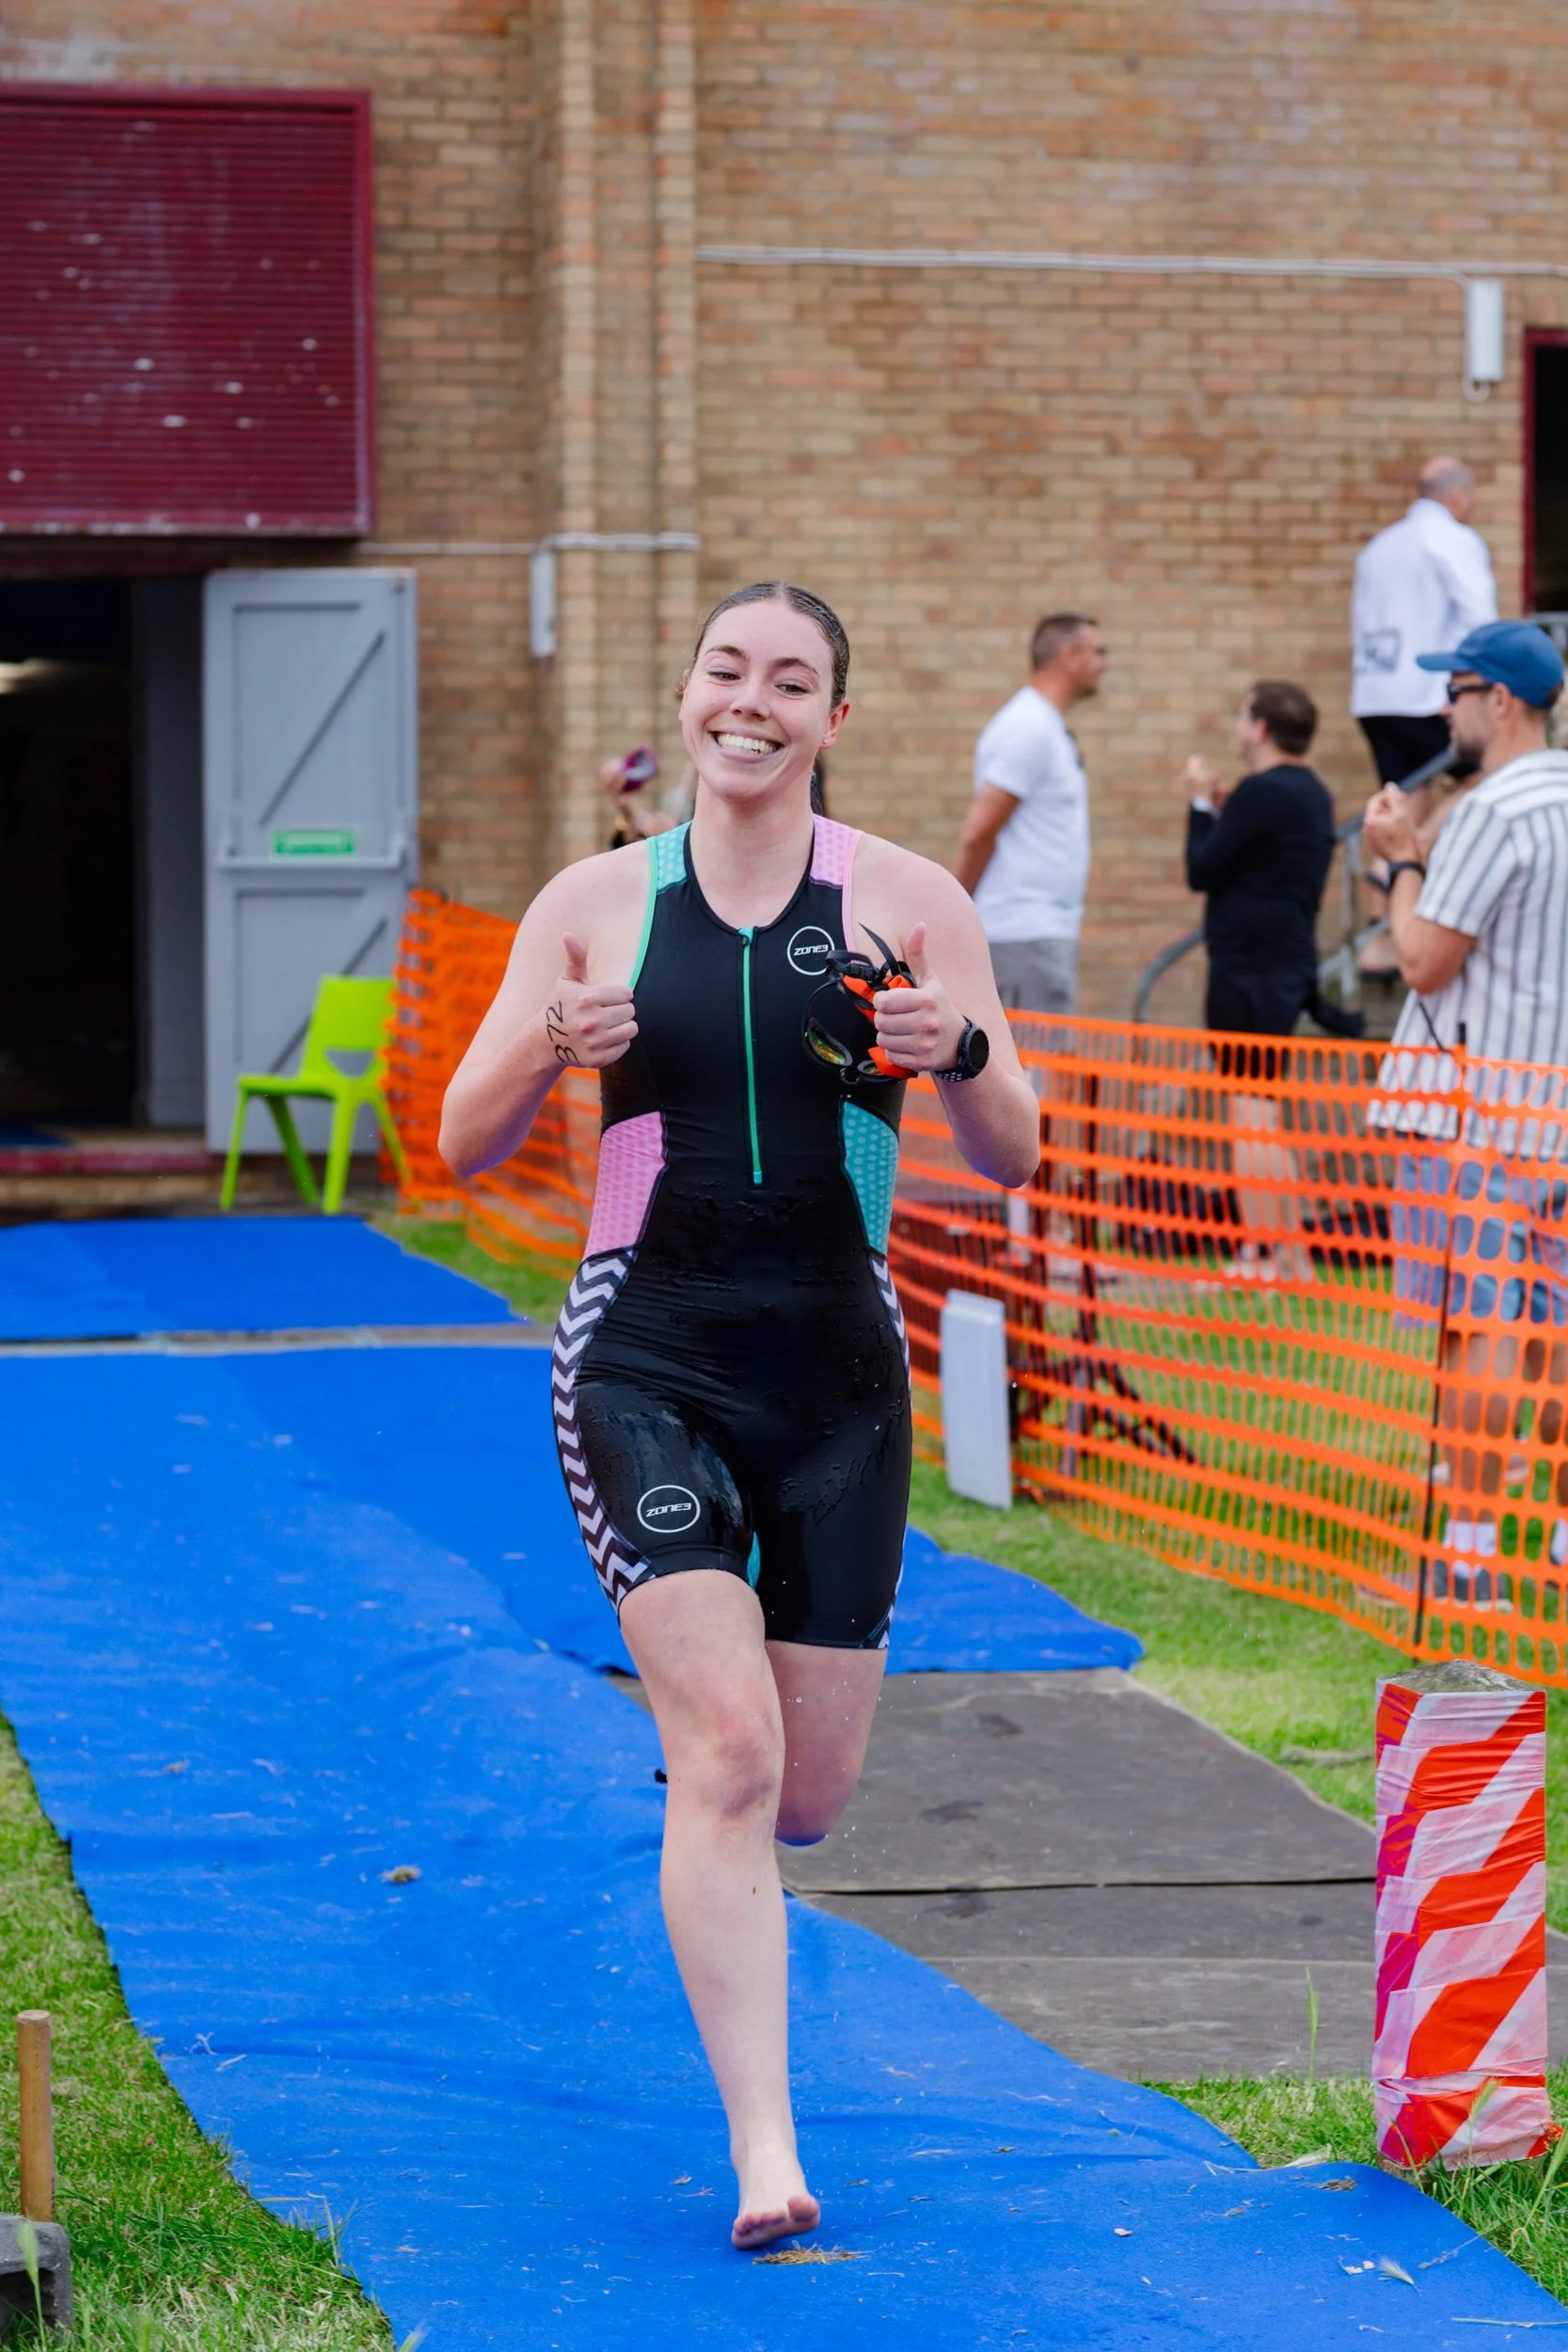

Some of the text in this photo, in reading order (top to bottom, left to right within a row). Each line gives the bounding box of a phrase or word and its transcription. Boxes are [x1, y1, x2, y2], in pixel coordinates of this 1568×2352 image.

[793, 944, 829, 957] ZONE3
[546, 1000, 579, 1064] 372
[645, 1502, 692, 1518] ZONE3
